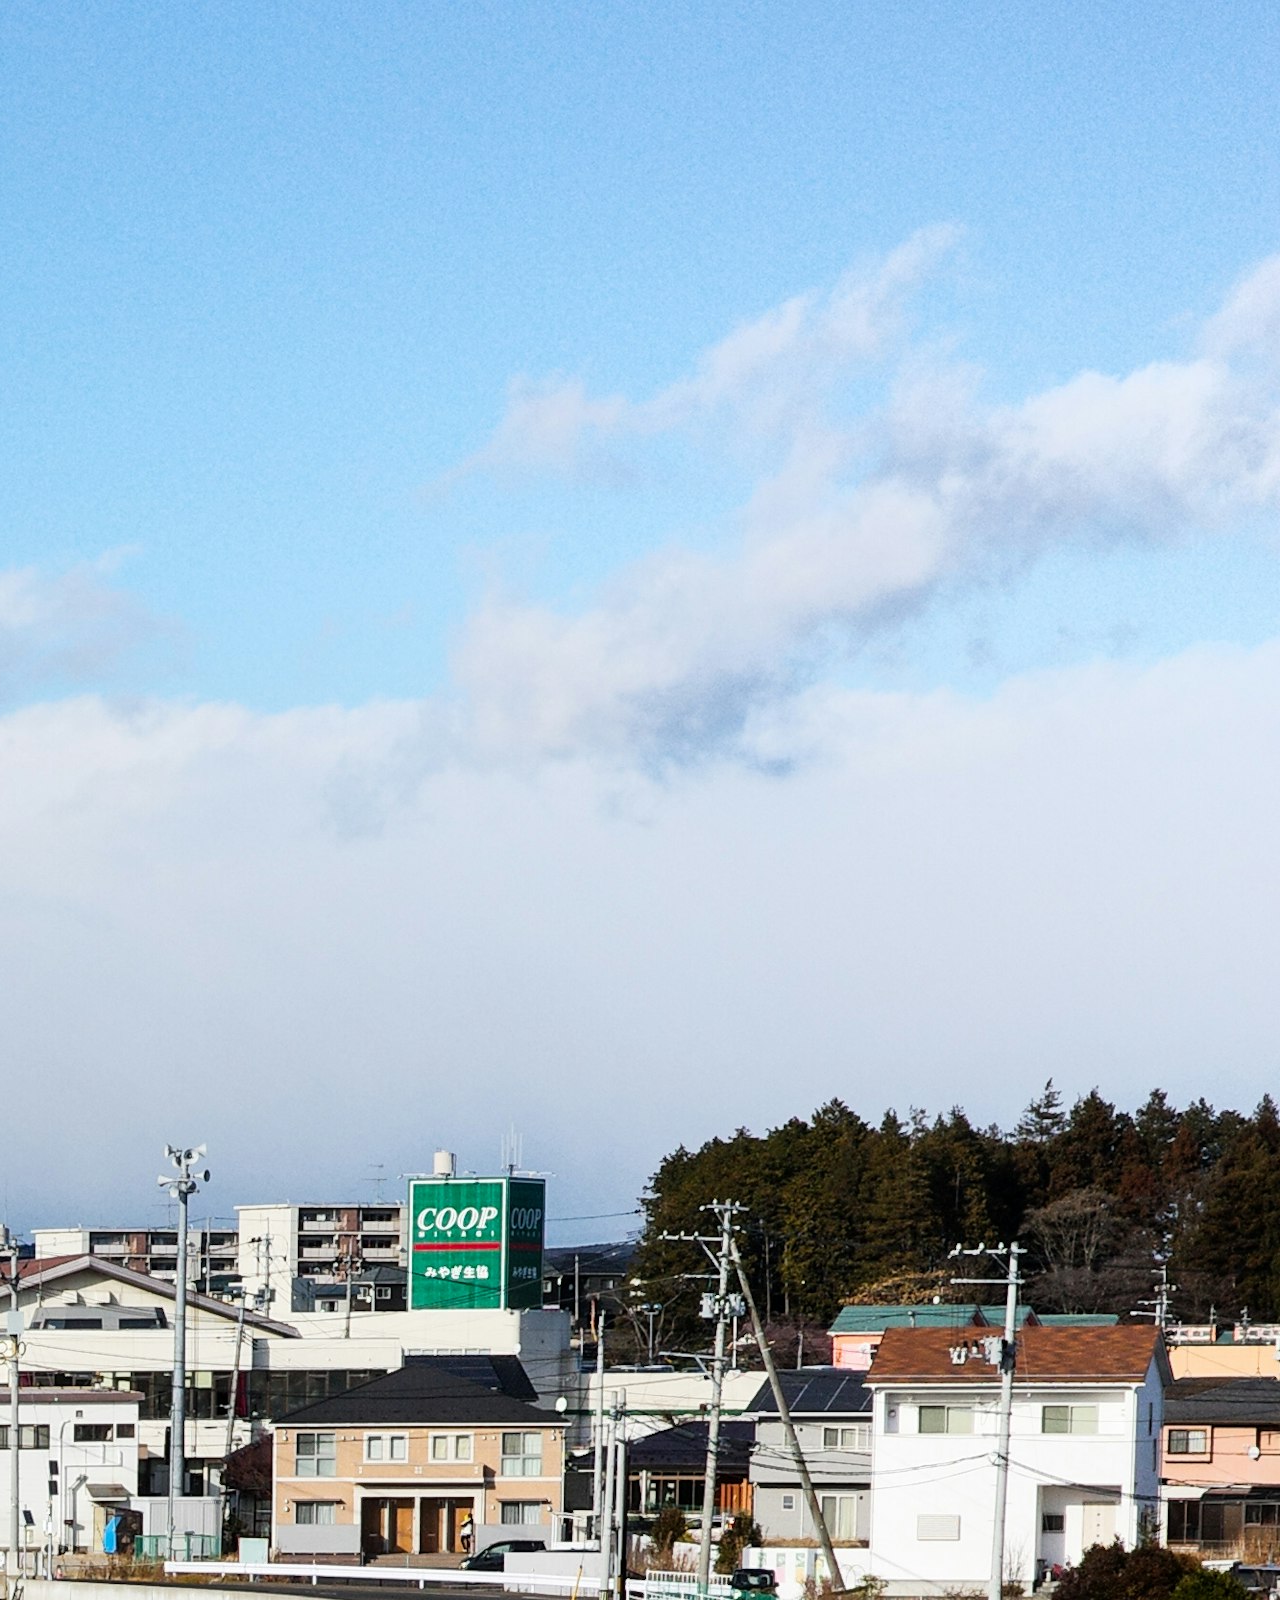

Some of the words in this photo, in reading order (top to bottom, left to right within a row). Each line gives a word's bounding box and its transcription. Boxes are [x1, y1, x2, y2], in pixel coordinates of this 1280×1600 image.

[417, 1207, 498, 1230] COOP
[511, 1208, 541, 1229] COOP
[425, 1265, 489, 1279] みやぎ生協
